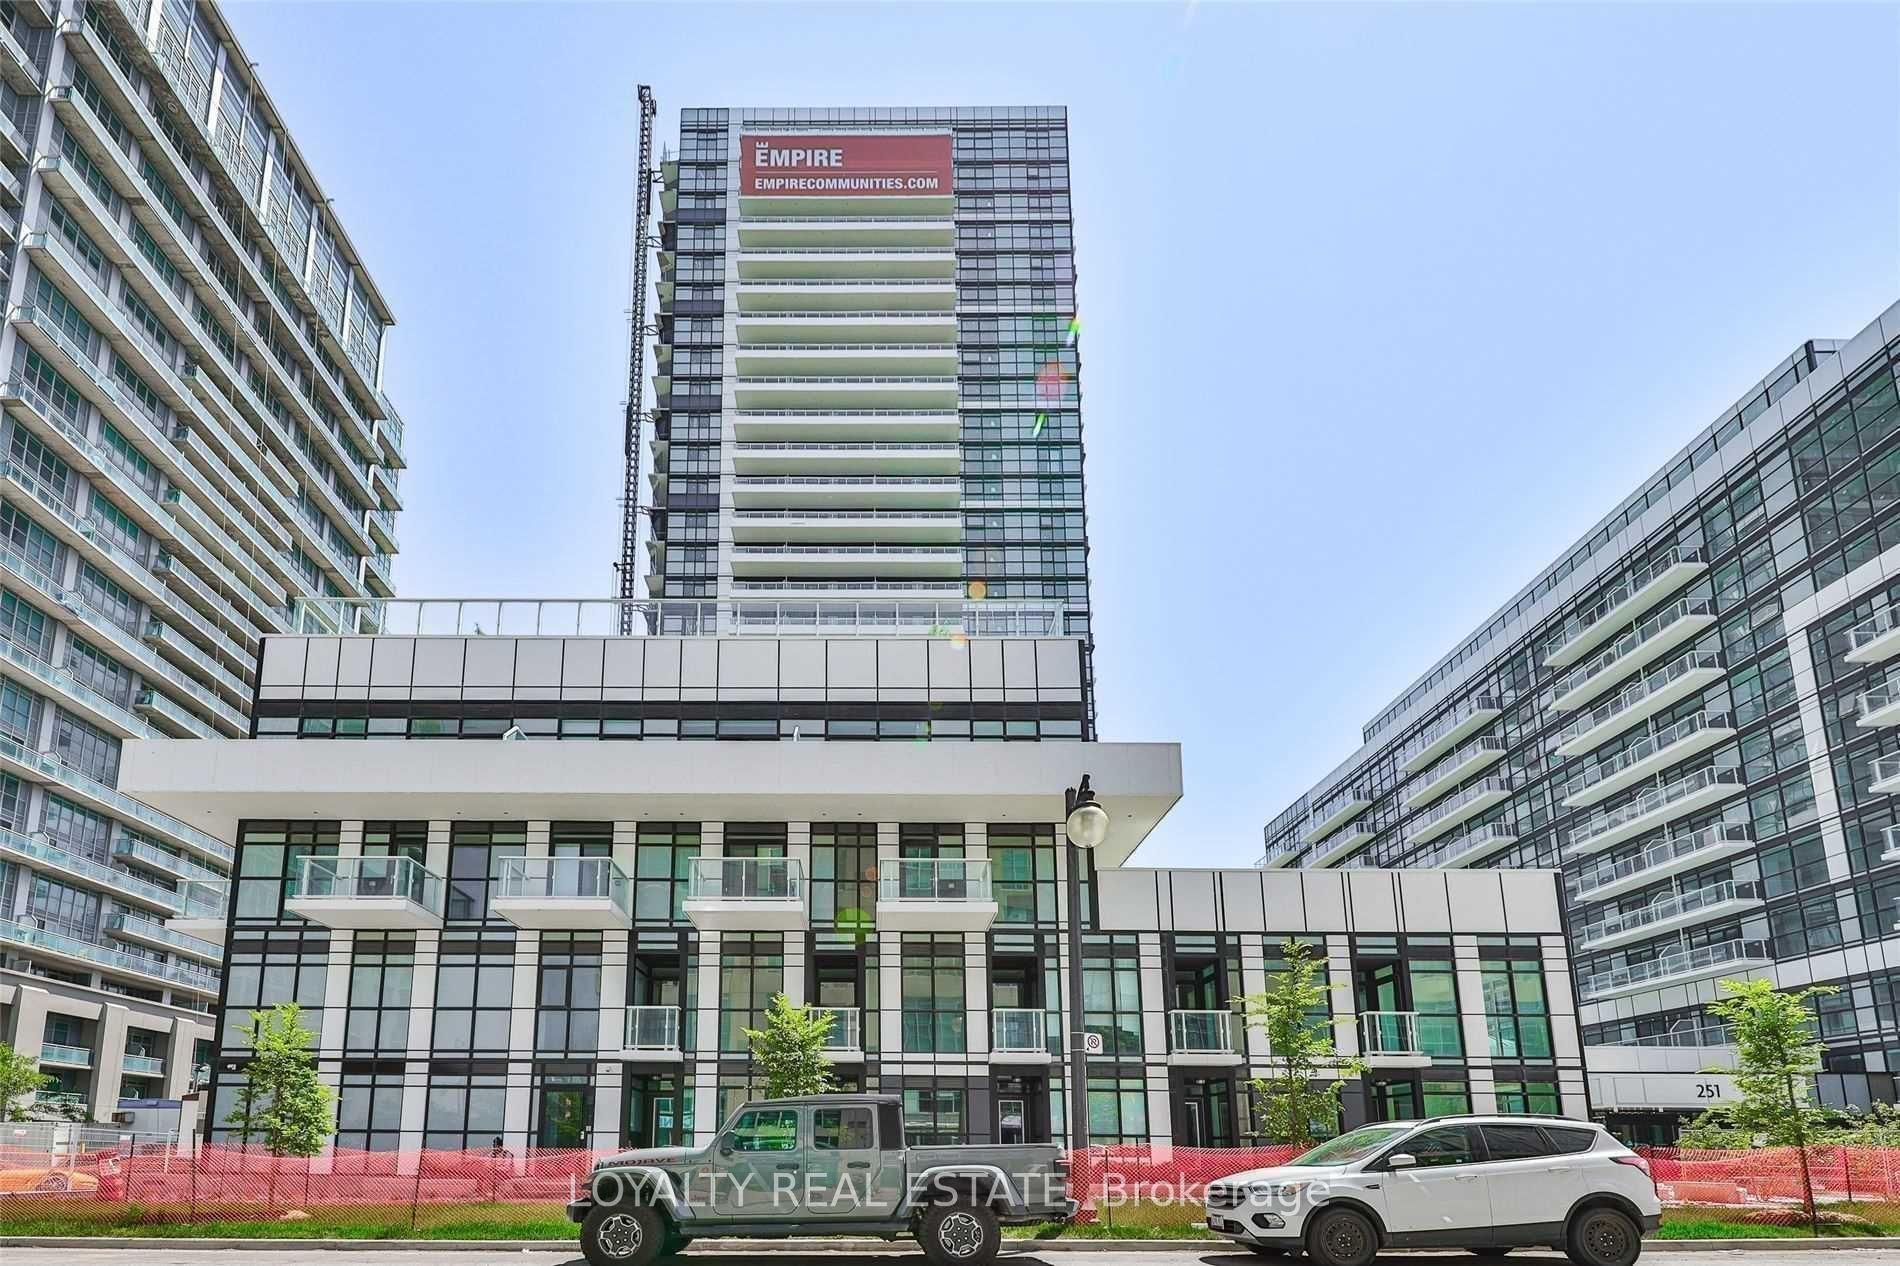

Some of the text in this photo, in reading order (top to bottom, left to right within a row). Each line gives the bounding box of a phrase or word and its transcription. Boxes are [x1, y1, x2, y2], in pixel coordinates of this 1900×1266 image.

[755, 149, 843, 167] EMPIRE
[755, 177, 938, 190] EMPIRECOMMUNITIES.COM
[1695, 1084, 1721, 1098] 251
[607, 1157, 677, 1167] MOJAVE
